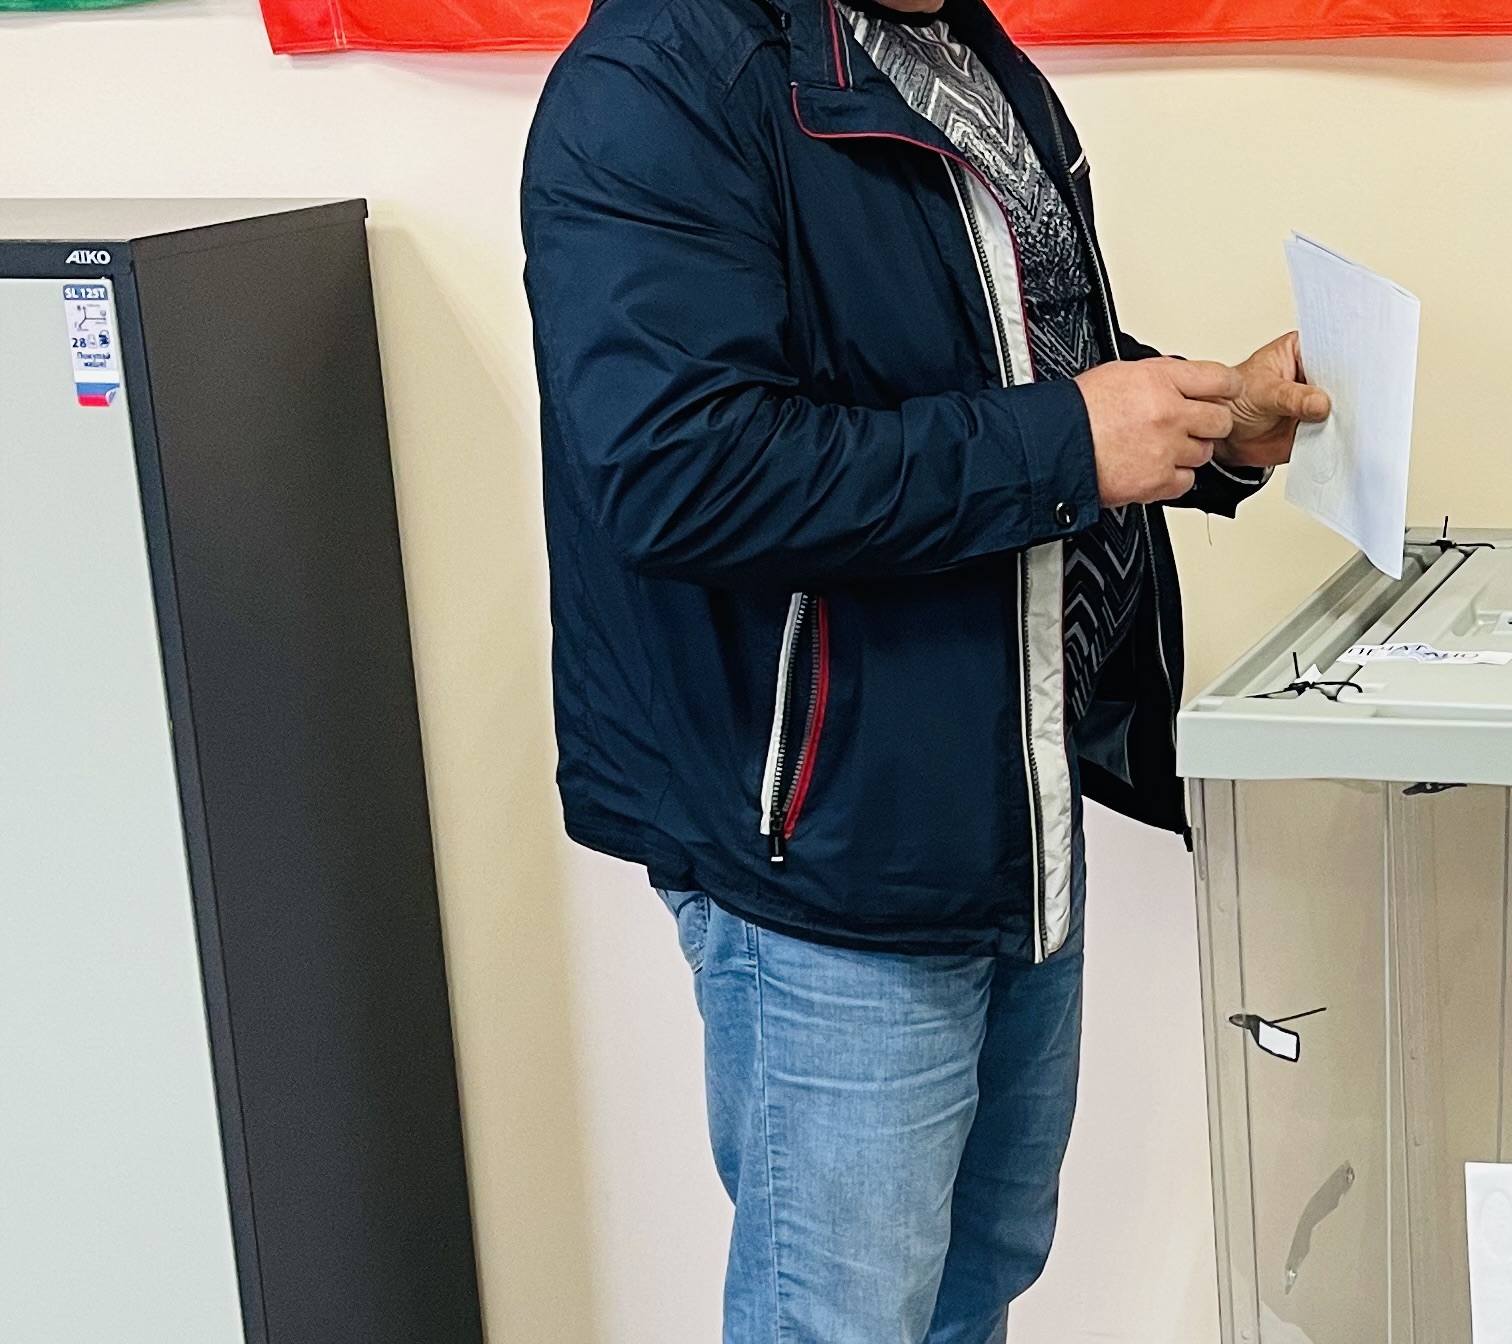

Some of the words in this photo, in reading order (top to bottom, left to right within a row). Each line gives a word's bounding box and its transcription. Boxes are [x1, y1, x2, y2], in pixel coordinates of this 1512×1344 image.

[65, 250, 111, 265] AIKO
[64, 287, 79, 299] SL
[72, 337, 87, 348] 28
